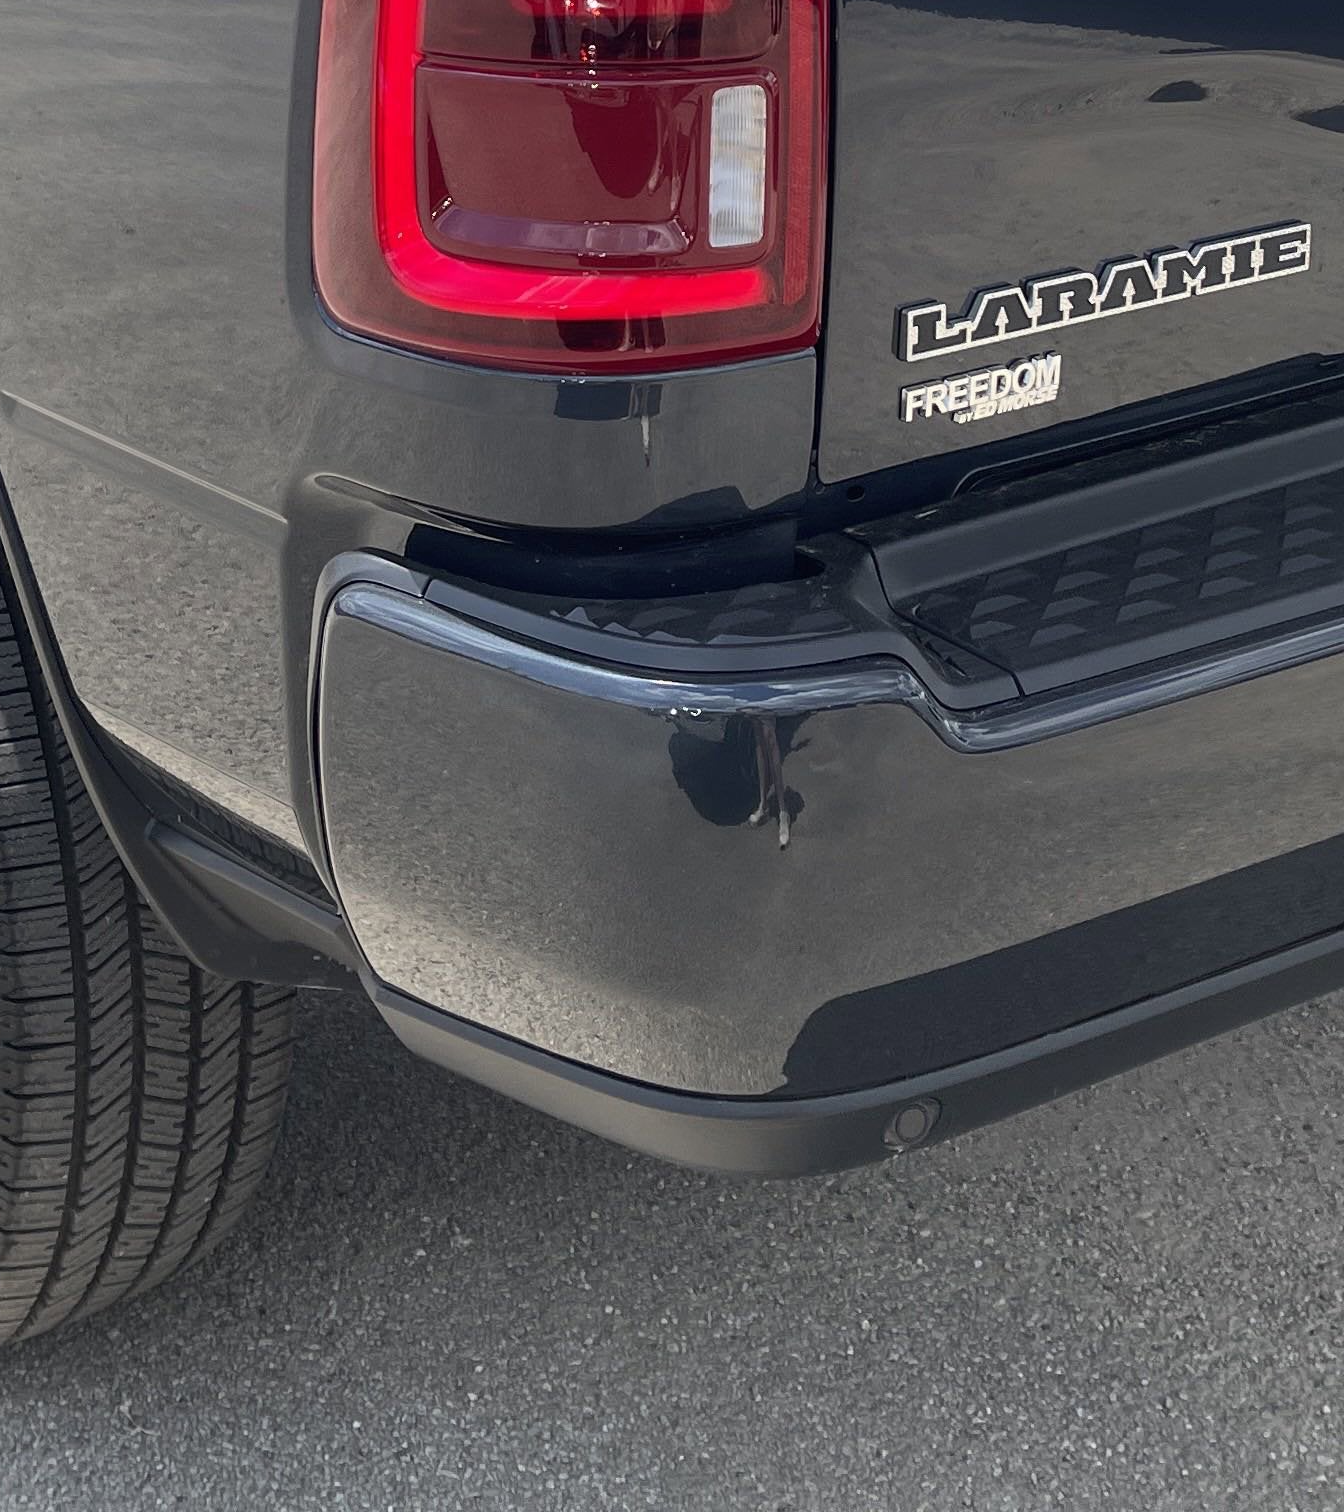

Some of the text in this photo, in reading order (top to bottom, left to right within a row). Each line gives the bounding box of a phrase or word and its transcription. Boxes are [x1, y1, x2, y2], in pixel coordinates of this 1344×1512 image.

[899, 221, 1312, 362] LARAMIE
[901, 353, 1062, 423] FREEDOM
[973, 400, 998, 420] ED
[997, 388, 1058, 414] MORSE
